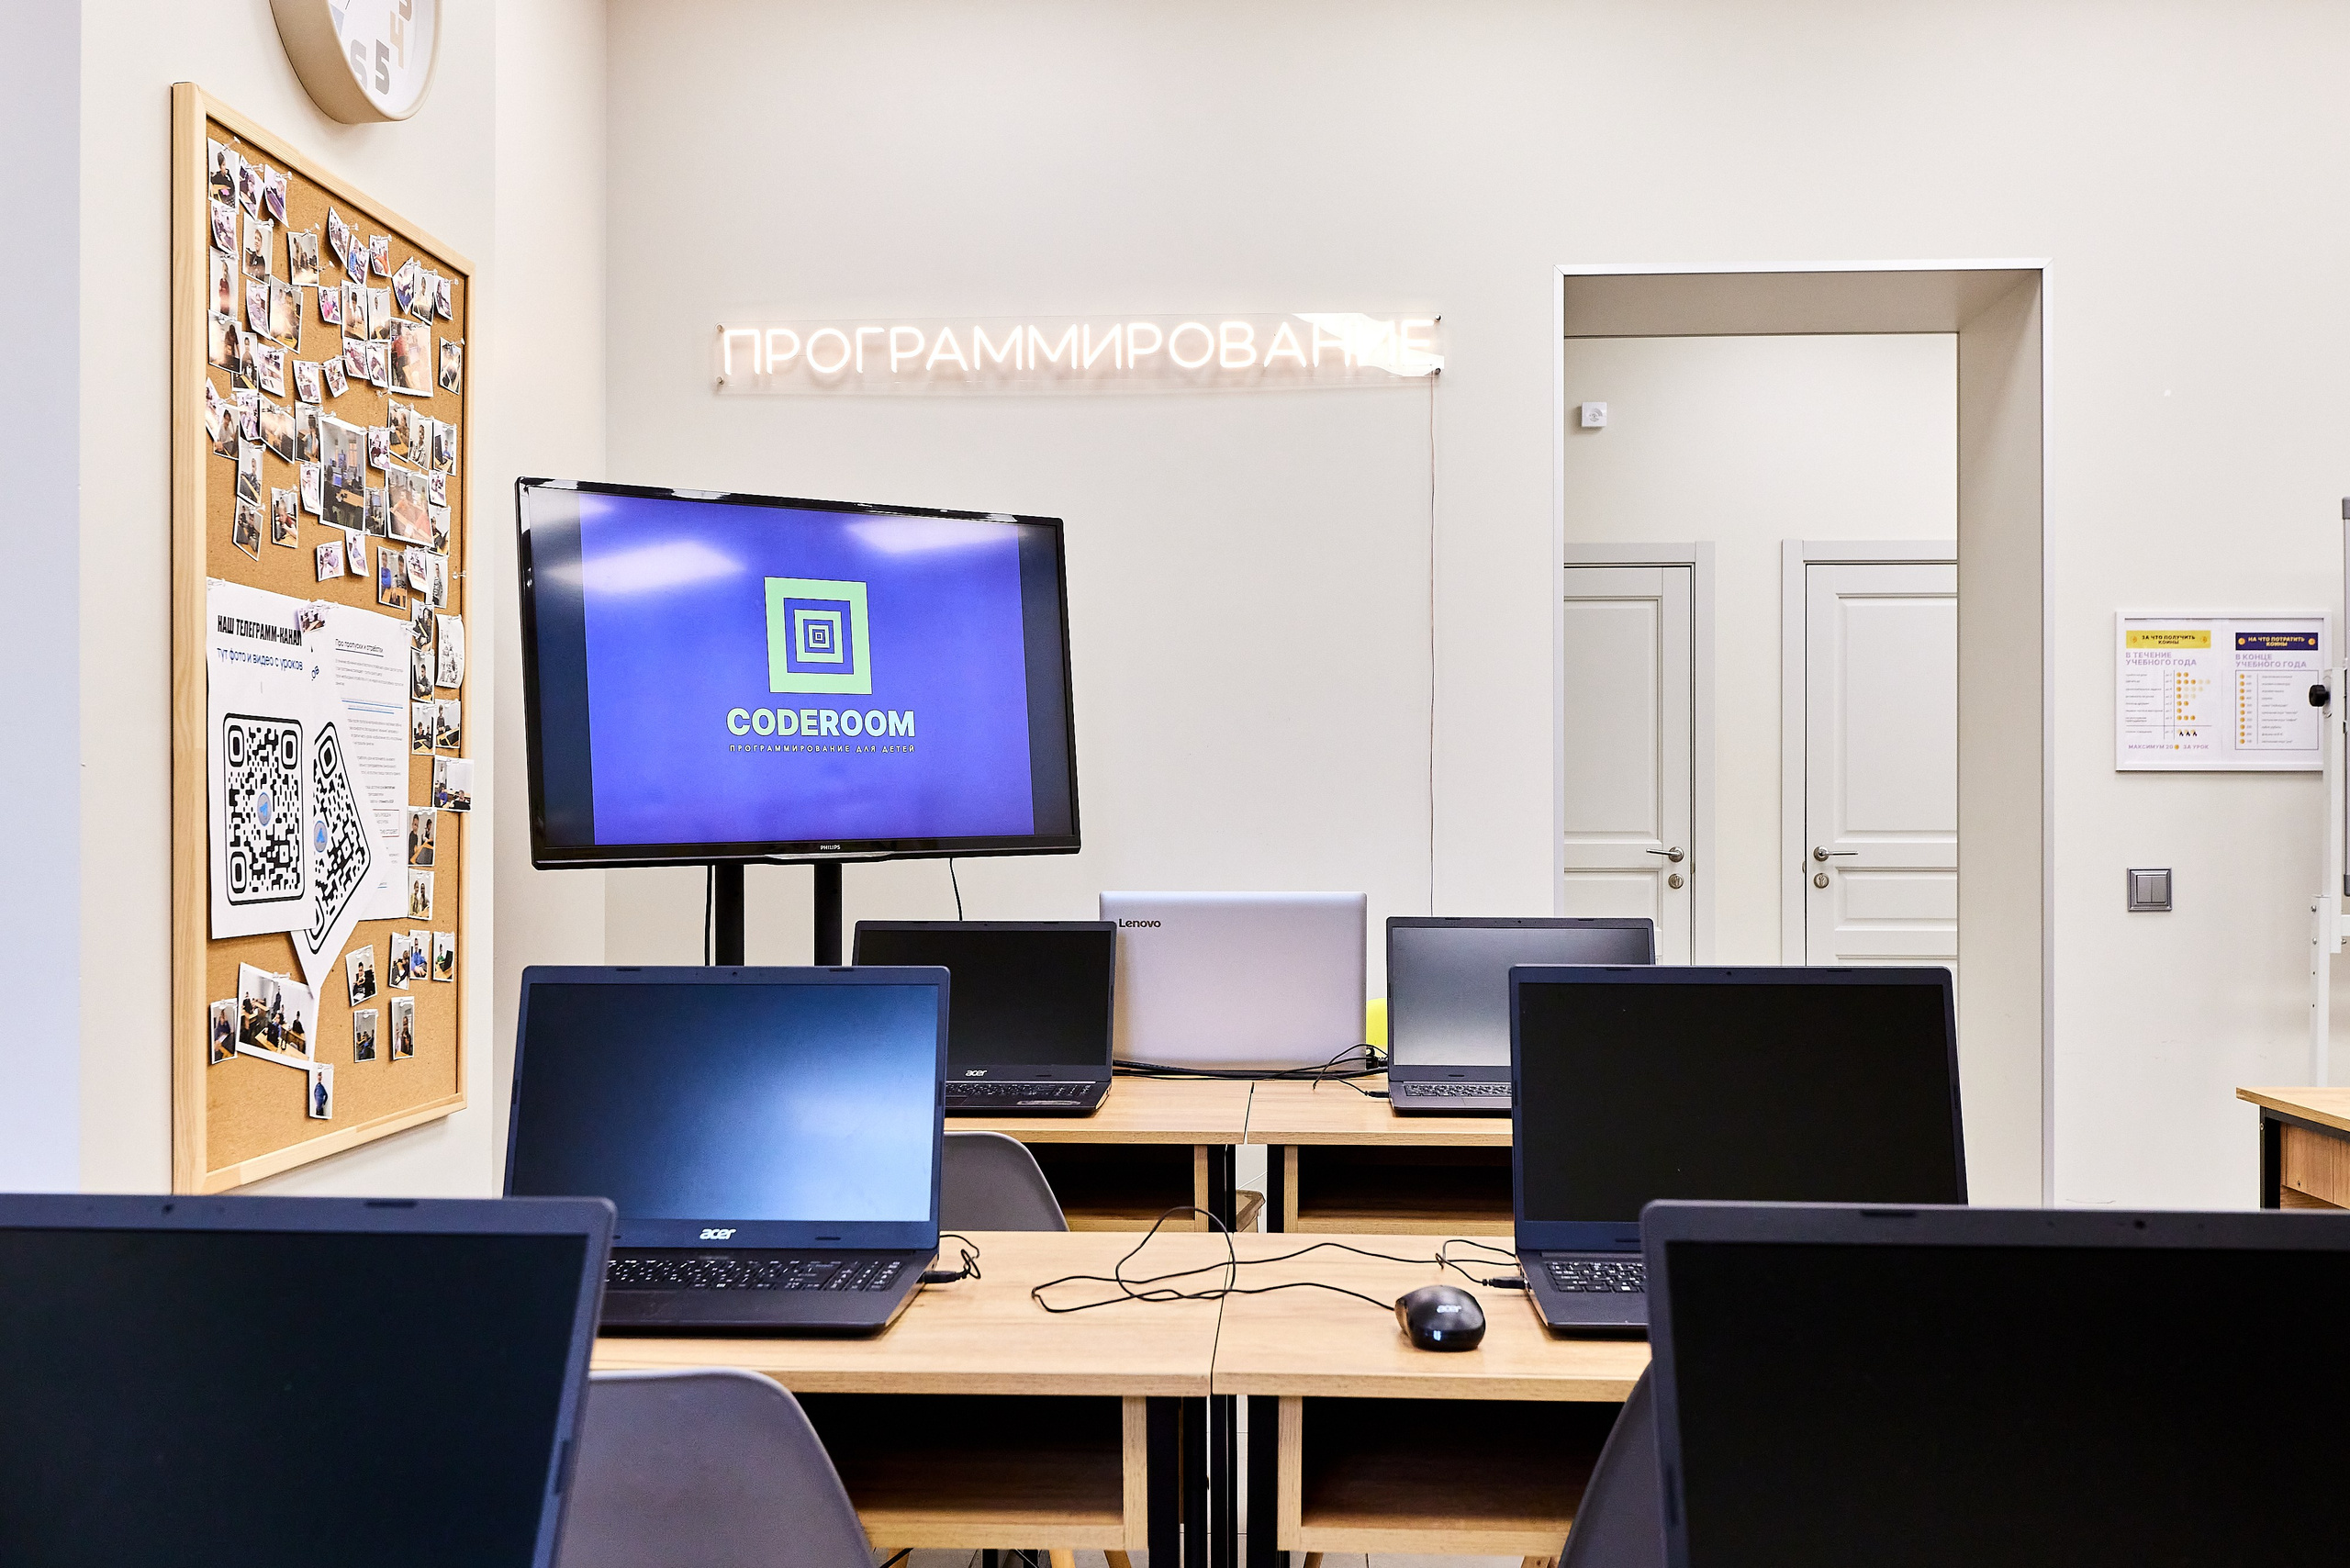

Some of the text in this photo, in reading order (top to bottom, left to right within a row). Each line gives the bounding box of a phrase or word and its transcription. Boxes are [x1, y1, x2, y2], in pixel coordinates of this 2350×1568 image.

[375, 39, 390, 95] 5
[723, 319, 1436, 375] ПРОГРАММИРОВАНИЕ
[217, 614, 303, 647] НАШ ТЕЛЕГРАММ-КАНАЛ
[217, 647, 303, 672] тут фото и видео с уроков
[726, 707, 916, 737] CODEROOM
[729, 745, 915, 753] ПРОГРАММИРОВАНИЕ ДЛЯ ДЕТЕЙ
[1119, 918, 1161, 928] Lenovo
[965, 1069, 988, 1077] acer
[699, 1228, 737, 1239] acer
[1436, 1305, 1462, 1314] acer
